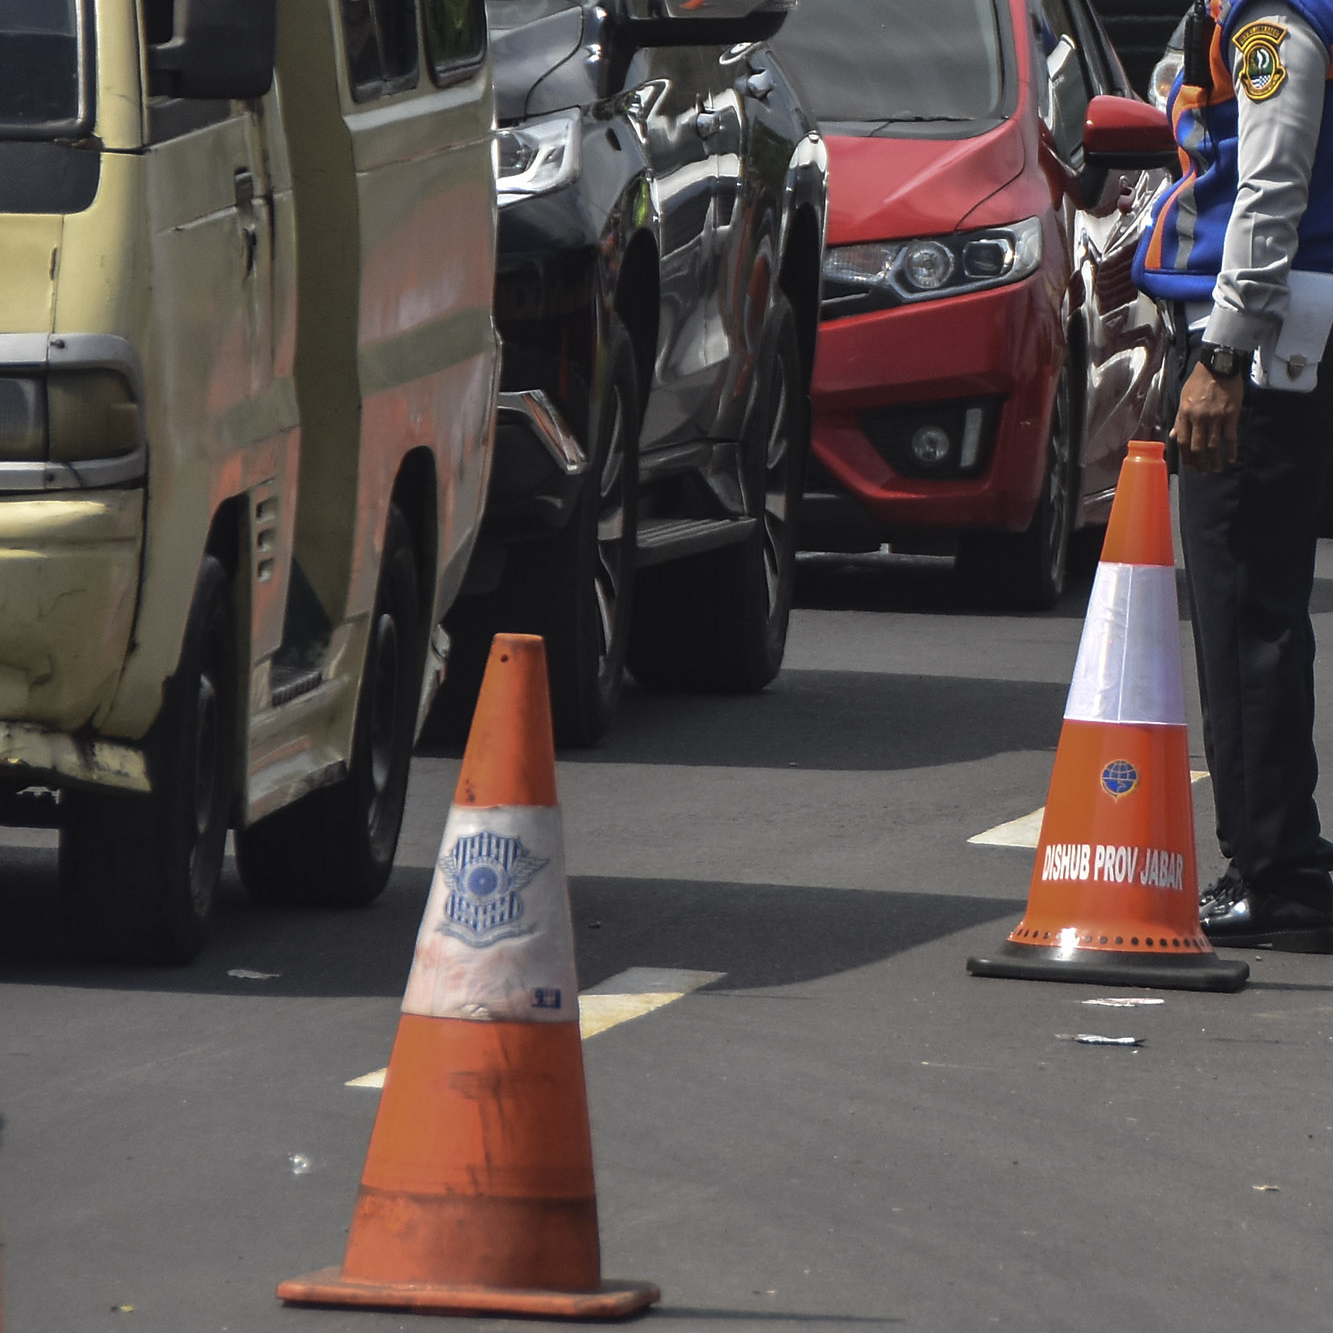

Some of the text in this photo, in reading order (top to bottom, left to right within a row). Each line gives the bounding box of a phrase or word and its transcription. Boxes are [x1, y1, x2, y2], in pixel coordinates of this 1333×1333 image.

[1042, 843, 1185, 891] DISHUB PROV JABAR
